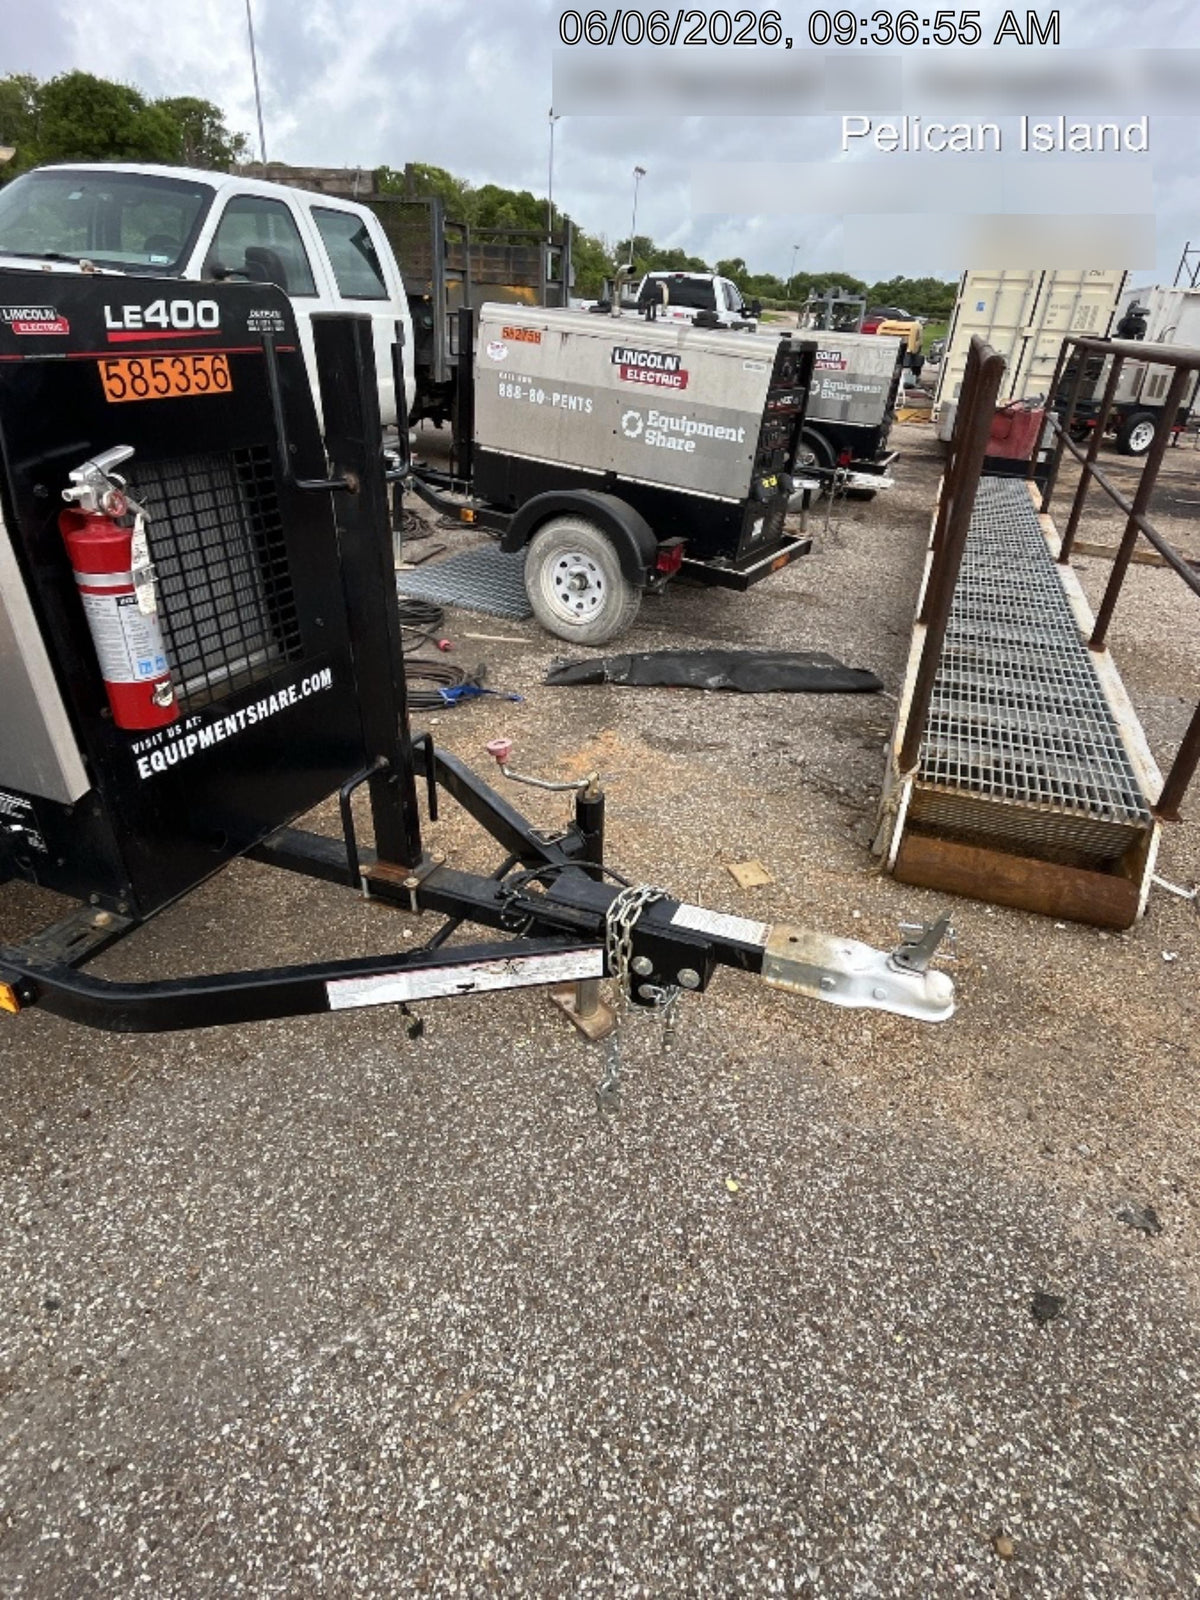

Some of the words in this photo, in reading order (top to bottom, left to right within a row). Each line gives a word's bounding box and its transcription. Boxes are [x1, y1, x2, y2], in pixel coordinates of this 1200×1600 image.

[3, 308, 56, 321] LINCOLN
[19, 322, 64, 332] ELECTRIC
[104, 299, 220, 330] LE400
[613, 349, 679, 371] LINCOLN
[104, 357, 230, 399] 585356
[626, 369, 683, 387] ELECTRIC
[646, 410, 746, 444] Equipment
[645, 430, 696, 453] Share
[136, 667, 333, 780] EQUIPMENTSHARE.COM
[131, 733, 164, 755] VISIT
[168, 725, 182, 738] US
